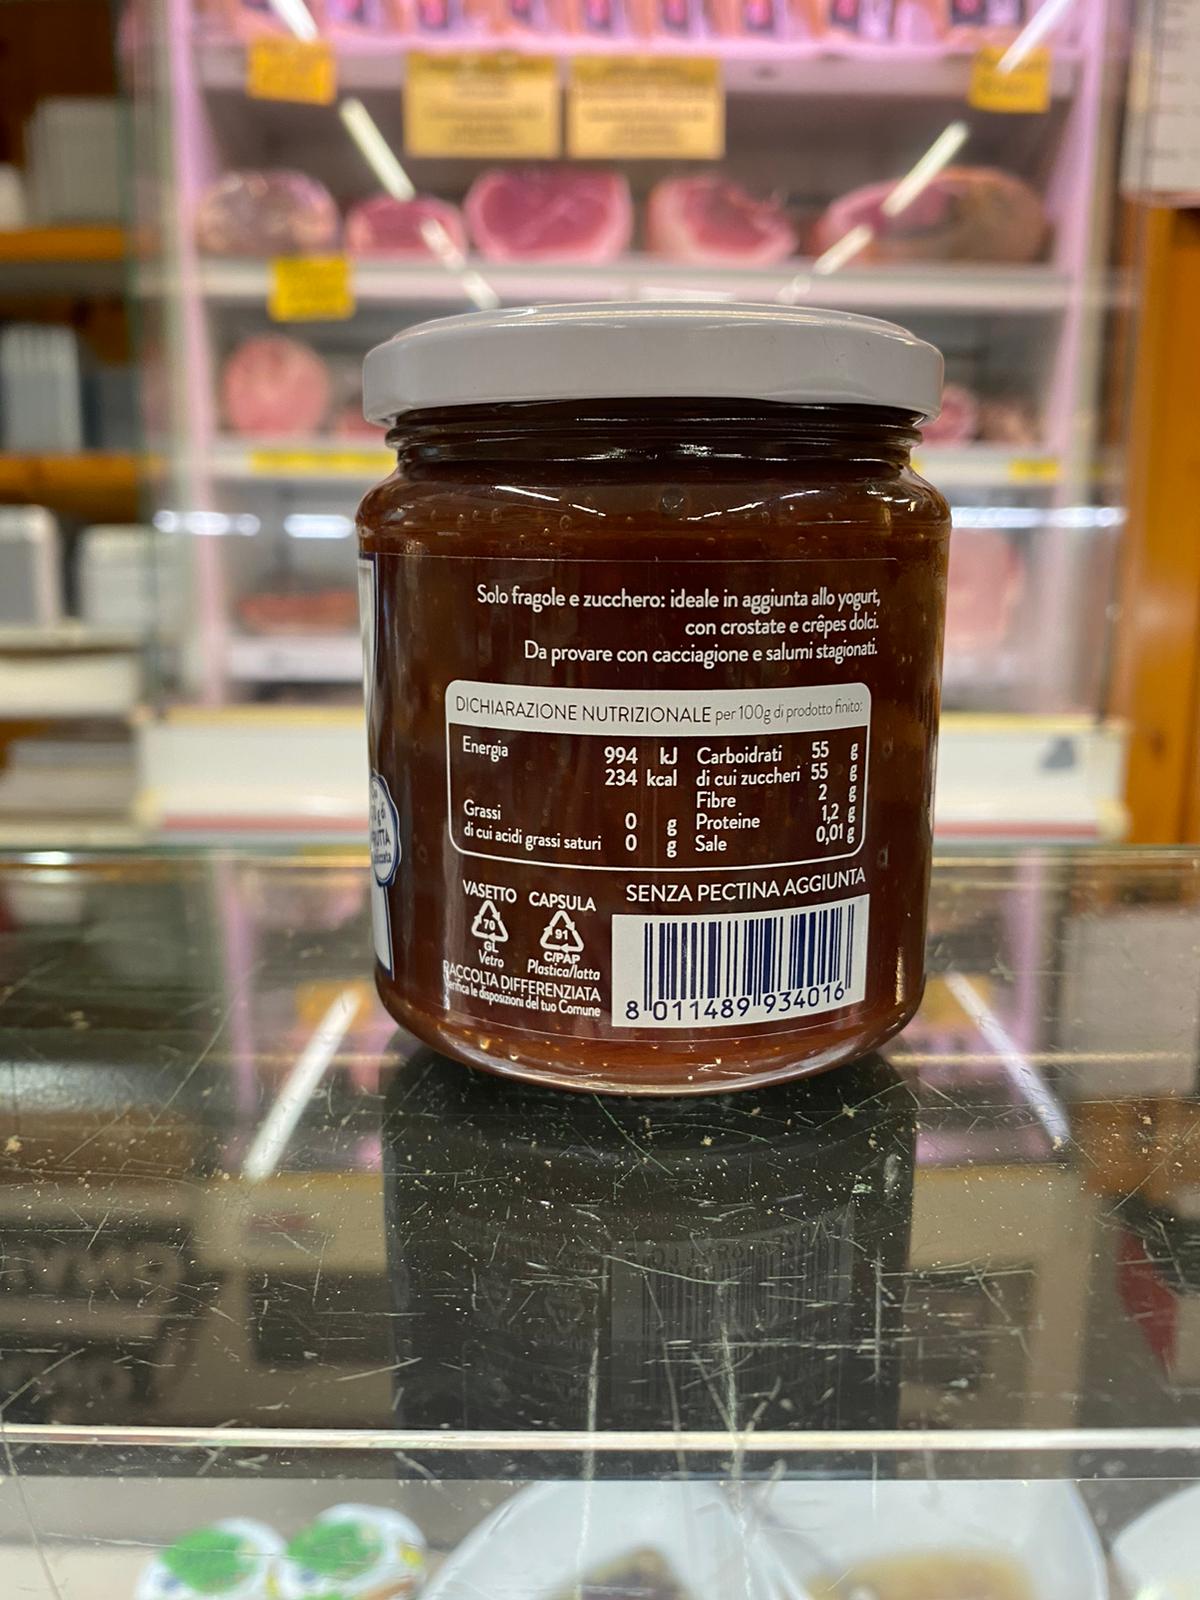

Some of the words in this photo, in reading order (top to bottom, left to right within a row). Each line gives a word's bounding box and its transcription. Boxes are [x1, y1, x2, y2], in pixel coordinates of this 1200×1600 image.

[477, 584, 508, 604] Solo
[512, 585, 566, 613] fragole
[569, 594, 580, 607] e
[583, 588, 666, 608] zucchero:
[671, 588, 719, 608] ideale
[723, 588, 738, 608] in
[742, 588, 808, 615] aggiunta
[811, 586, 835, 606] allo
[838, 588, 881, 612] yogurt,
[685, 622, 716, 635] con
[720, 619, 786, 635] crostate
[789, 620, 799, 633] e
[802, 614, 846, 639] crêpes
[849, 611, 879, 631] dolci.
[524, 640, 547, 659] Da
[551, 648, 613, 667] provare
[617, 649, 648, 662] con
[652, 643, 748, 670] cacciagione
[752, 648, 762, 661] e
[766, 641, 813, 661] salumi
[816, 637, 878, 664] stagionati.
[456, 695, 577, 721] DICHIARAZIONE
[582, 705, 712, 723] NUTRIZIONALE
[715, 708, 736, 725] per
[739, 704, 771, 724] 100g
[774, 704, 784, 719] di
[786, 702, 833, 723] prodotto
[835, 698, 864, 714] finito:
[462, 735, 509, 762] Energia
[604, 746, 638, 764] 994
[659, 746, 678, 765] kJ
[697, 745, 782, 765] Carboidrati
[811, 740, 829, 759] 55
[850, 742, 858, 761] g
[604, 768, 638, 786] 234
[646, 769, 677, 787] kcal
[696, 769, 710, 787] di
[714, 769, 737, 786] cui
[740, 765, 801, 785] zuccheri
[810, 762, 828, 781] 55
[849, 764, 858, 782] g
[696, 791, 737, 808] Fibre
[818, 784, 827, 801] 2
[848, 785, 857, 803] g
[463, 799, 501, 820] Grassi
[625, 812, 637, 830] 0
[667, 818, 677, 836] g
[696, 812, 760, 830] Proteine
[821, 803, 839, 825] 1,2
[847, 806, 856, 824] g
[463, 821, 474, 836] di
[476, 825, 493, 840] cui
[495, 828, 522, 844] acidi
[525, 833, 561, 851] grassi
[564, 835, 602, 851] saturi
[625, 834, 637, 851] 0
[666, 839, 677, 858] g
[695, 835, 727, 852] Sale
[815, 823, 843, 845] 0,01
[846, 826, 855, 844] g
[462, 879, 517, 904] VASETTO
[626, 883, 693, 901] SENZA
[698, 880, 780, 901] PECTINA
[783, 866, 866, 896] AGGIUNTA
[528, 891, 597, 912] CAPSULA
[483, 918, 496, 931] 70
[555, 929, 568, 940] 91
[478, 949, 504, 968] Vetro
[483, 940, 499, 953] GL
[543, 951, 581, 965] C/PAP
[443, 960, 499, 988] RACCOLTA
[501, 975, 601, 1002] DIFFERENZIATA
[527, 959, 600, 981] Plastica/latta
[470, 983, 478, 997] le
[479, 986, 524, 1007] disposizioni
[525, 995, 539, 1010] del
[541, 1000, 556, 1012] tuo
[558, 1000, 601, 1017] Comune
[625, 1000, 639, 1020] 8
[652, 997, 750, 1021] 011489
[763, 980, 844, 1013] 934016
